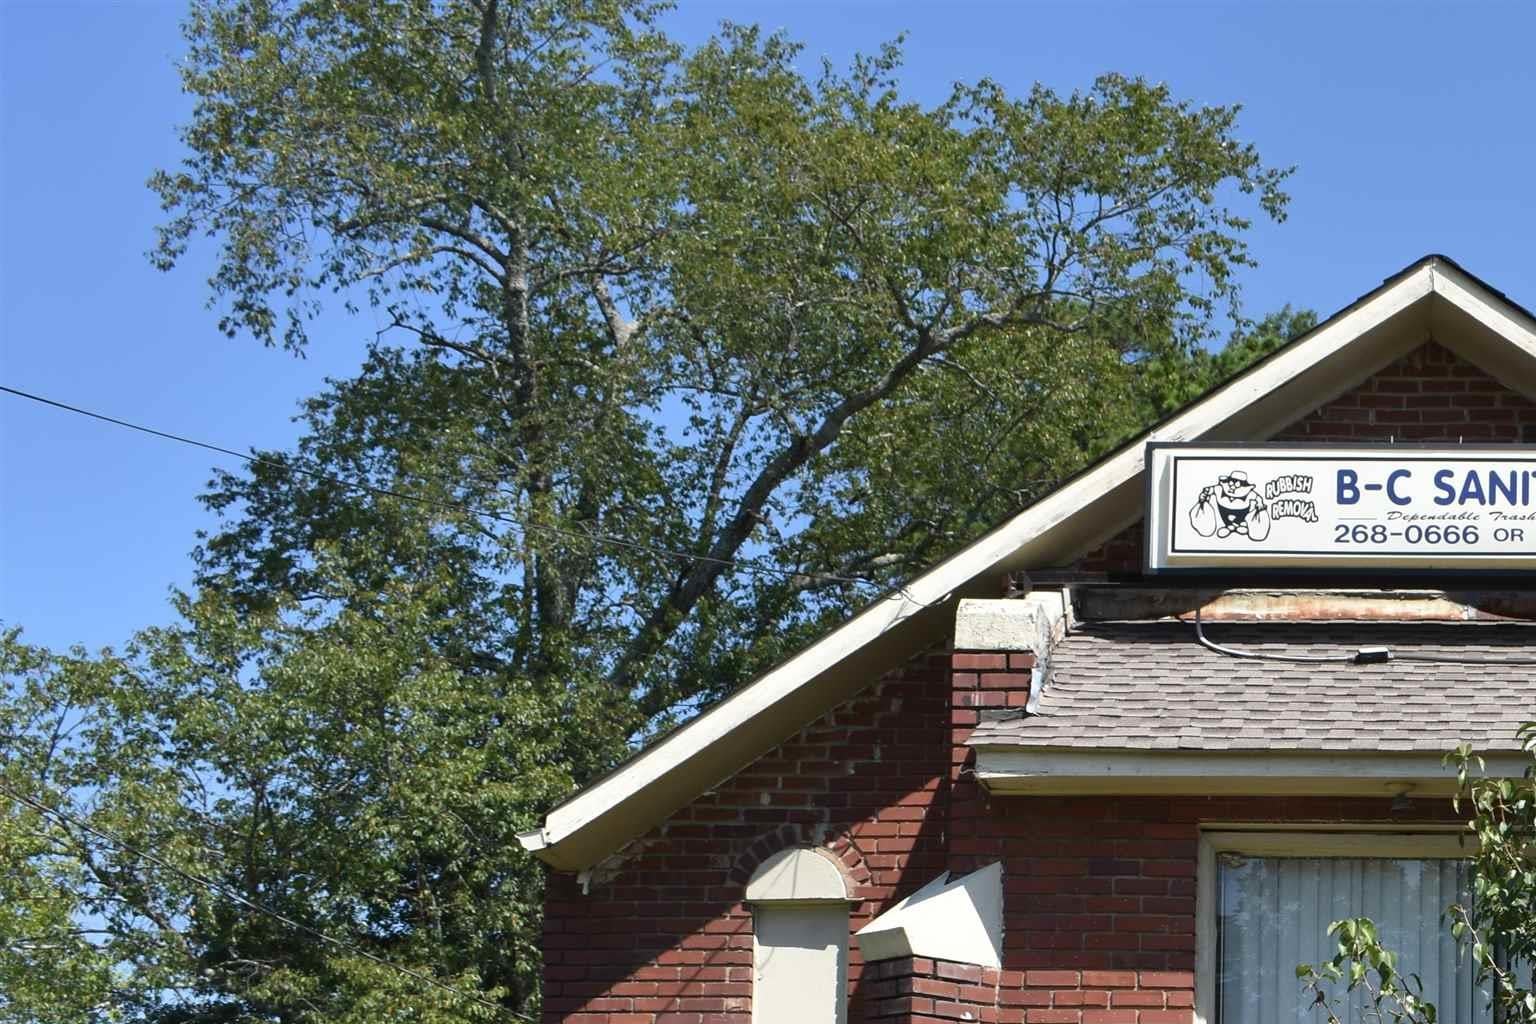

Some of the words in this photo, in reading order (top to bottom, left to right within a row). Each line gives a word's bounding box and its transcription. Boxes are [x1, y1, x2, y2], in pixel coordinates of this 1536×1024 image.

[1265, 474, 1313, 500] RUBBISH
[1336, 469, 1412, 506] B-C
[1271, 499, 1319, 523] REMOVAL
[1386, 510, 1481, 522] Dependable
[1488, 511, 1536, 521] Trash
[1334, 524, 1480, 545] 268-0666
[1493, 528, 1525, 543] OR
